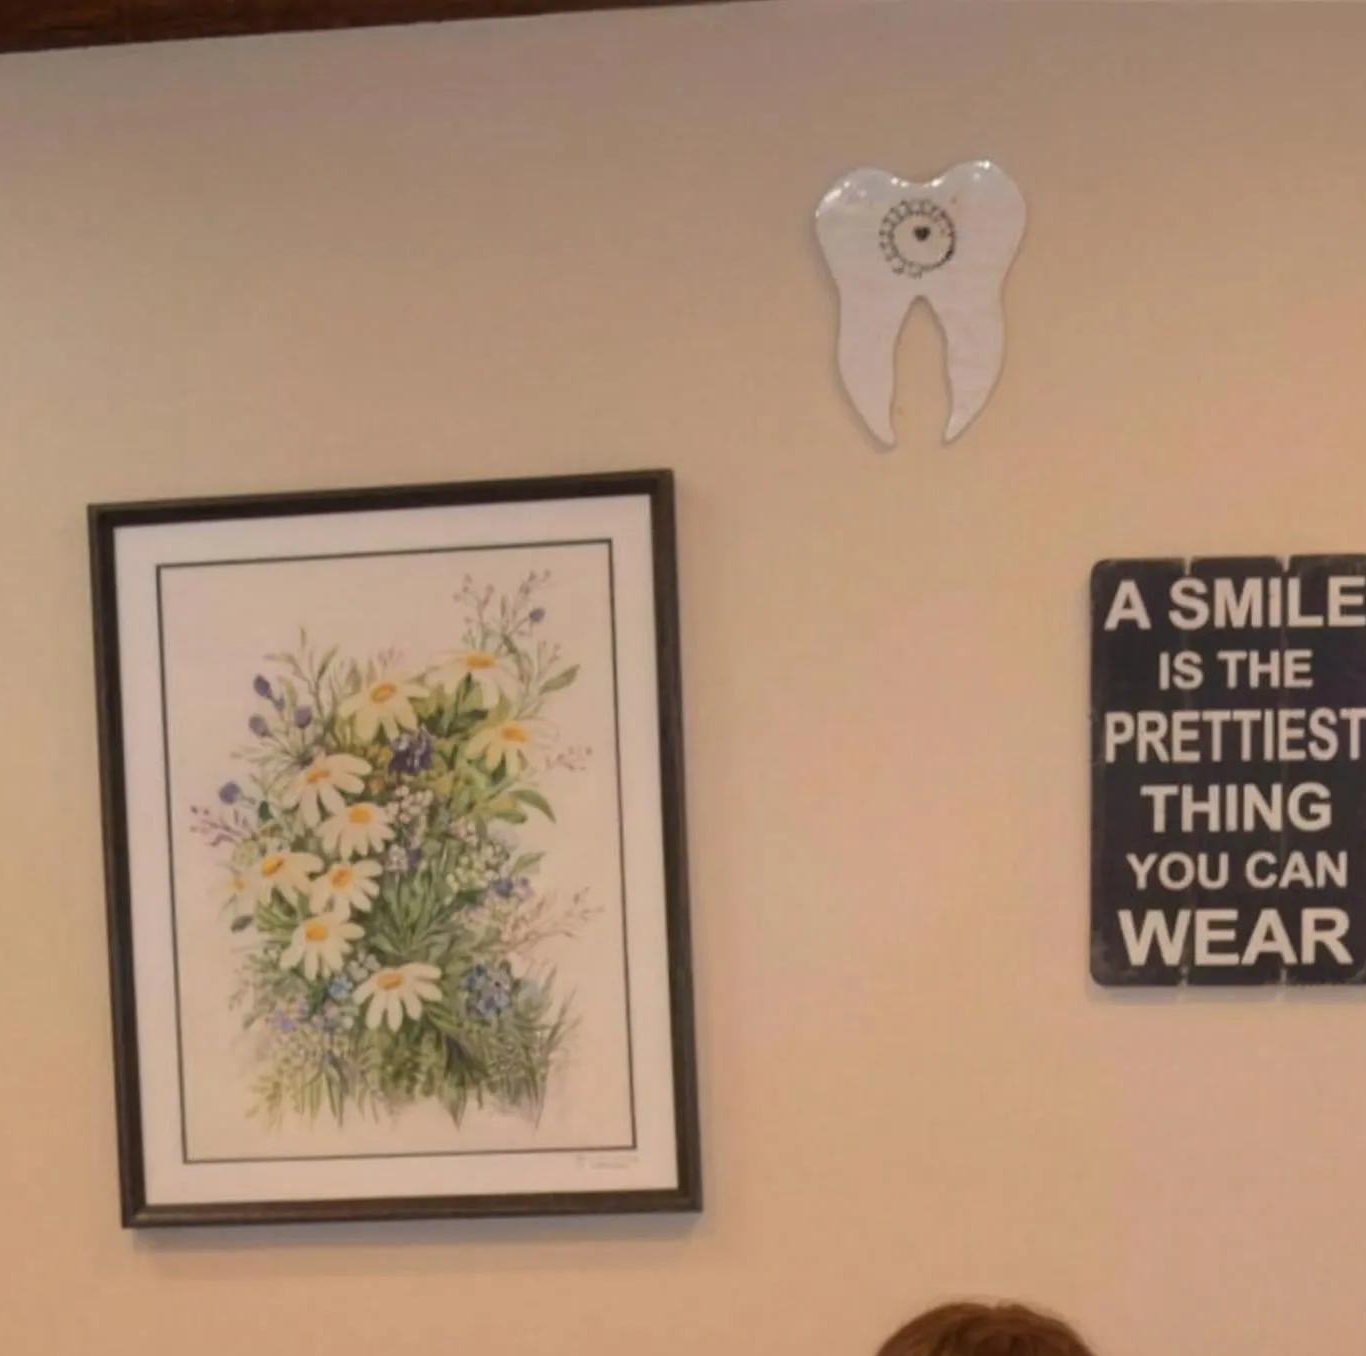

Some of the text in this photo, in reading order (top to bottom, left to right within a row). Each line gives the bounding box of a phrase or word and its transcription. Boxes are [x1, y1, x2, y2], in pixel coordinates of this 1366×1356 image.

[1105, 579, 1151, 630] A
[1160, 651, 1313, 689] IS THE
[1140, 783, 1332, 832] THING
[1127, 852, 1348, 889] YOU CAN
[1118, 909, 1352, 966] WEAR
